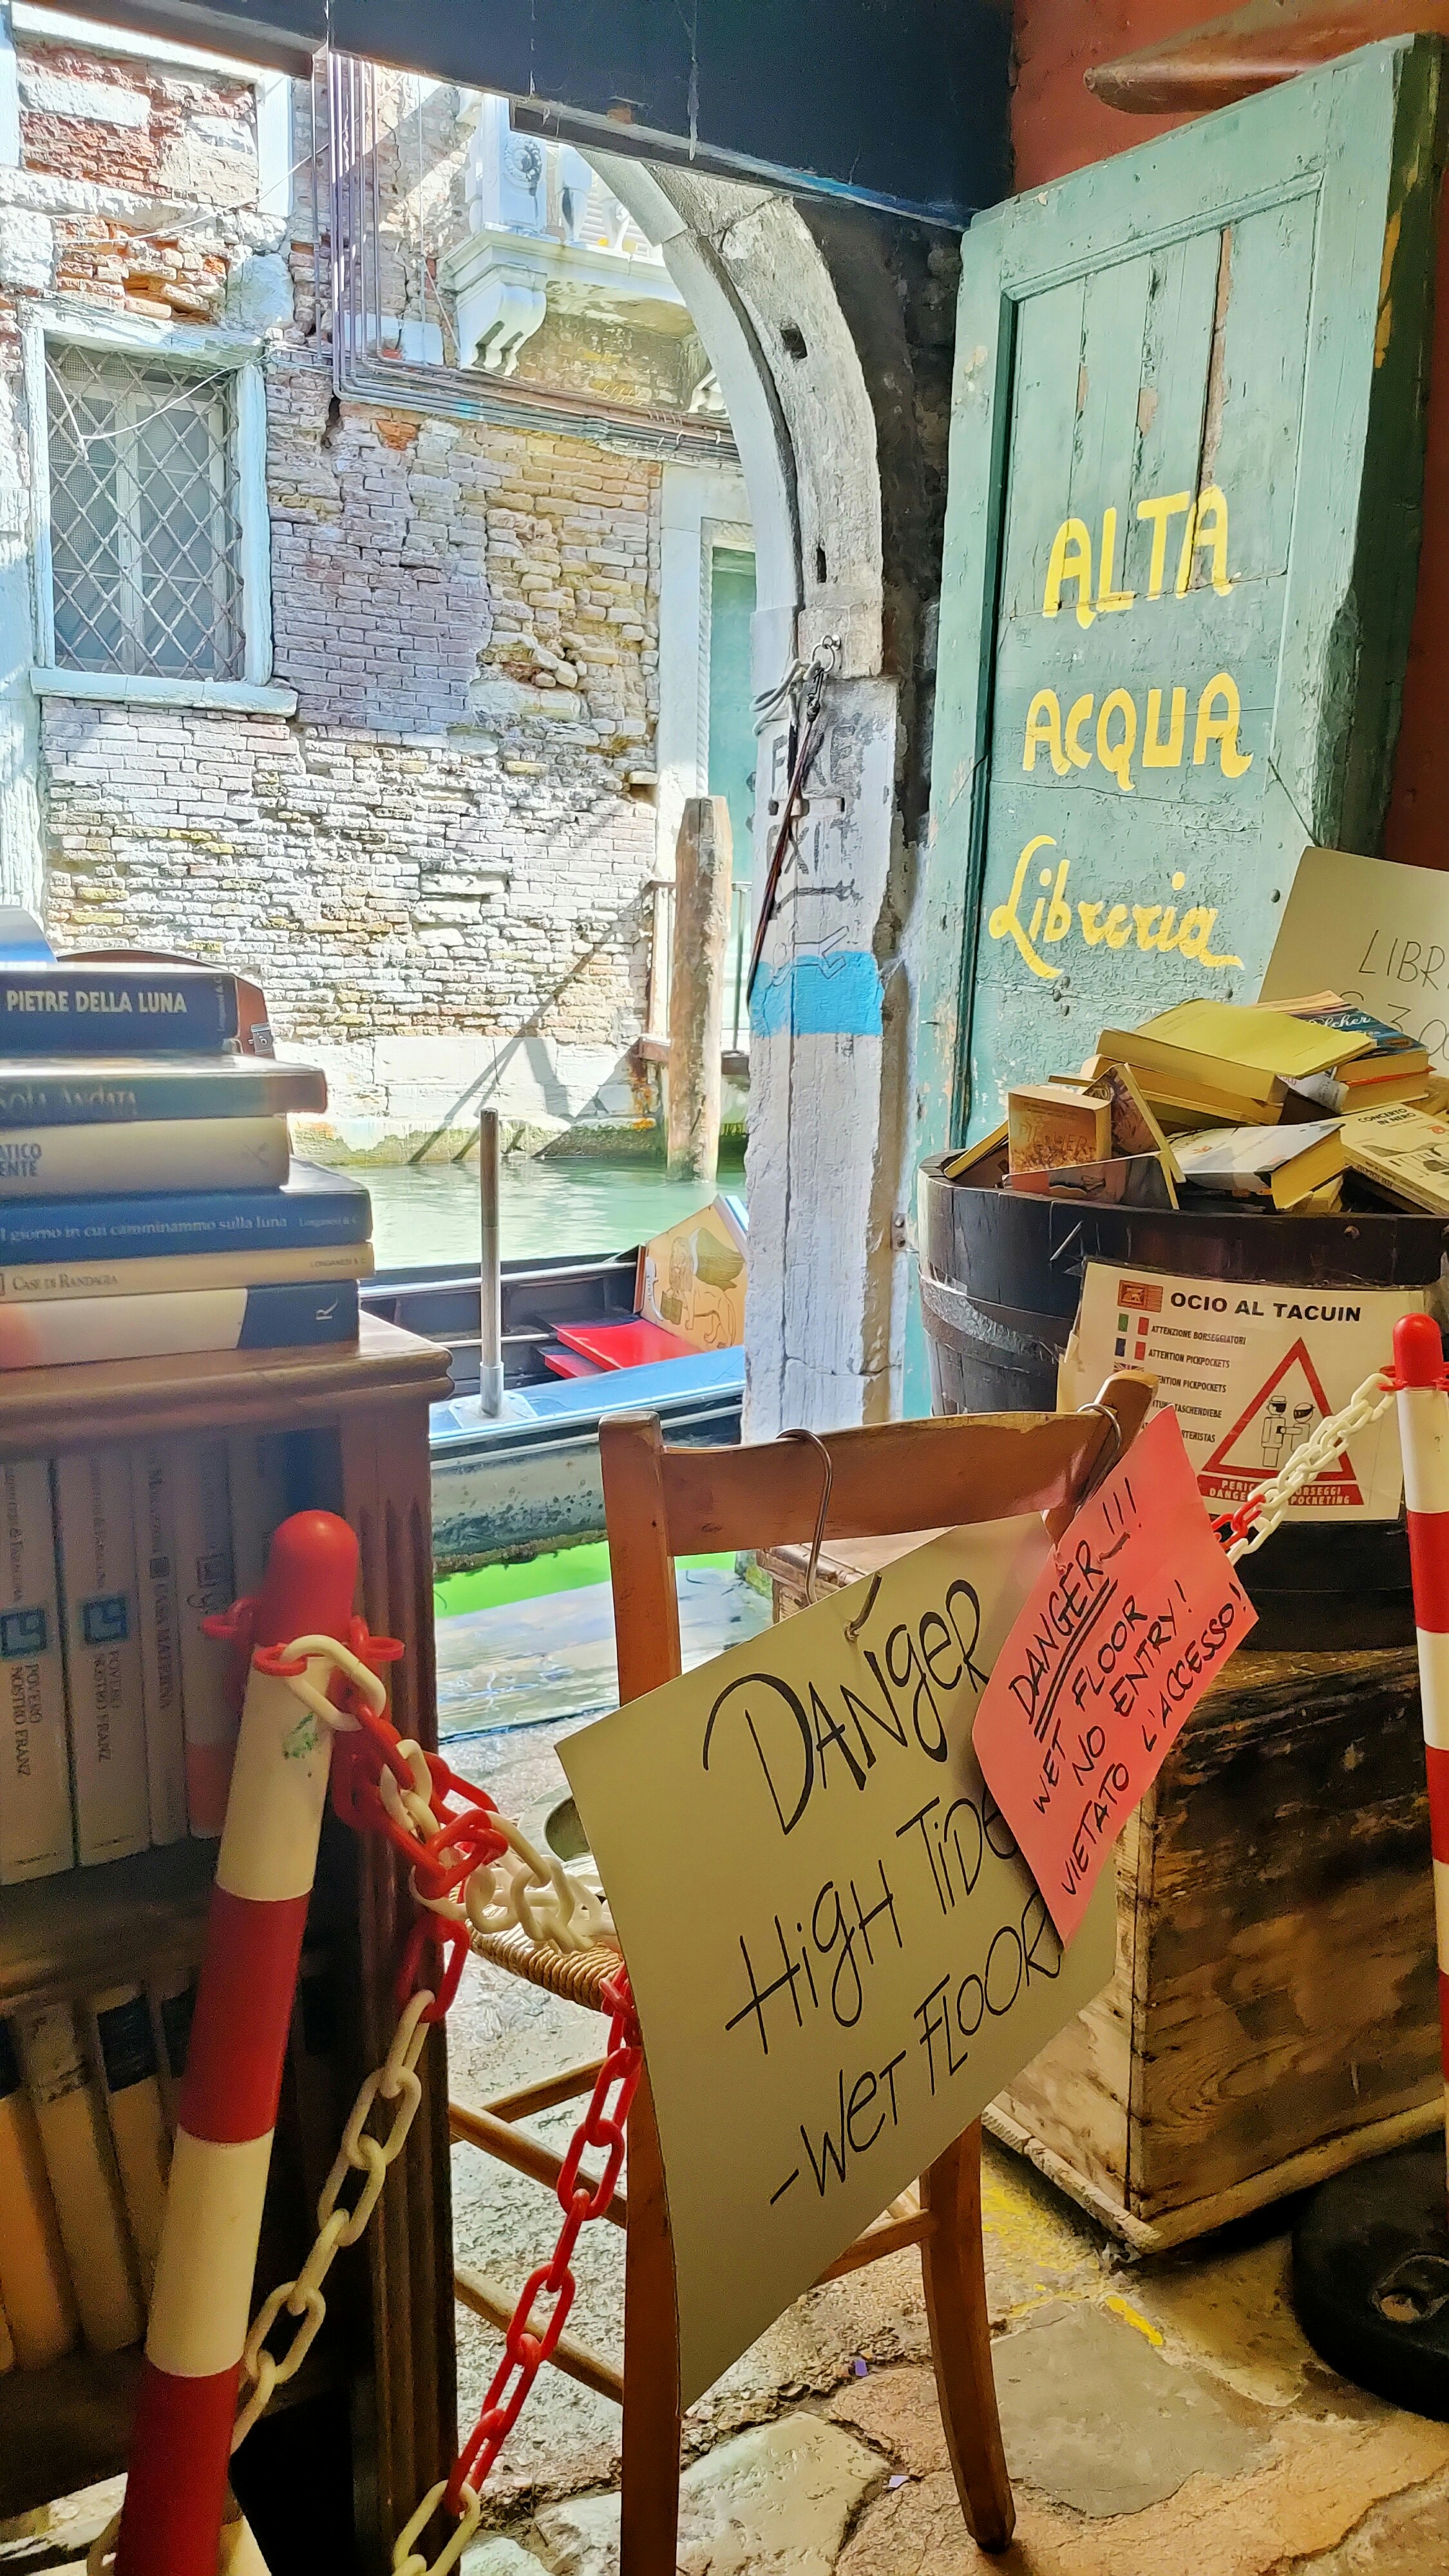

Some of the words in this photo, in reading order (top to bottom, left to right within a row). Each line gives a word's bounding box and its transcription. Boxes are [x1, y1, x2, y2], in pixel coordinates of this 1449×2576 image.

[1043, 484, 1233, 630] ALTA
[1023, 672, 1253, 791] ACQUA
[989, 835, 1245, 980] Libreria
[1358, 929, 1449, 990] LIBR
[6, 990, 69, 1012] PIETRE
[75, 990, 133, 1013] DELLA
[138, 992, 188, 1014] LUNA
[1358, 1108, 1408, 1123] CONCERTO
[1391, 1112, 1416, 1123] NERO
[256, 1215, 287, 1228] luna
[1170, 1292, 1227, 1313] OCIO
[1235, 1300, 1265, 1317] AL
[1273, 1302, 1362, 1322] TACUIN
[1151, 1325, 1192, 1339] ATTENZIONE
[1193, 1331, 1246, 1345] BORSEGGIATORI
[1148, 1349, 1184, 1363] ATTENTION
[1186, 1355, 1230, 1368] PICKPOCKETS
[1158, 1375, 1181, 1388] ENTION
[1183, 1379, 1227, 1393] PICKPOCKETS
[1174, 1404, 1222, 1418] TASCHENDIEBE
[1181, 1429, 1216, 1443] RTERISTAS
[1222, 1480, 1255, 1491] PERIC
[1209, 1488, 1249, 1501] DANGE
[1290, 1495, 1350, 1505] POCKETING
[1072, 1725, 1106, 1787] NO
[1109, 1579, 1192, 1718] ENTRY!
[1033, 1717, 1066, 1815] WET
[1072, 1594, 1148, 1712] FLOOR
[1061, 1763, 1130, 1897] VIETATO
